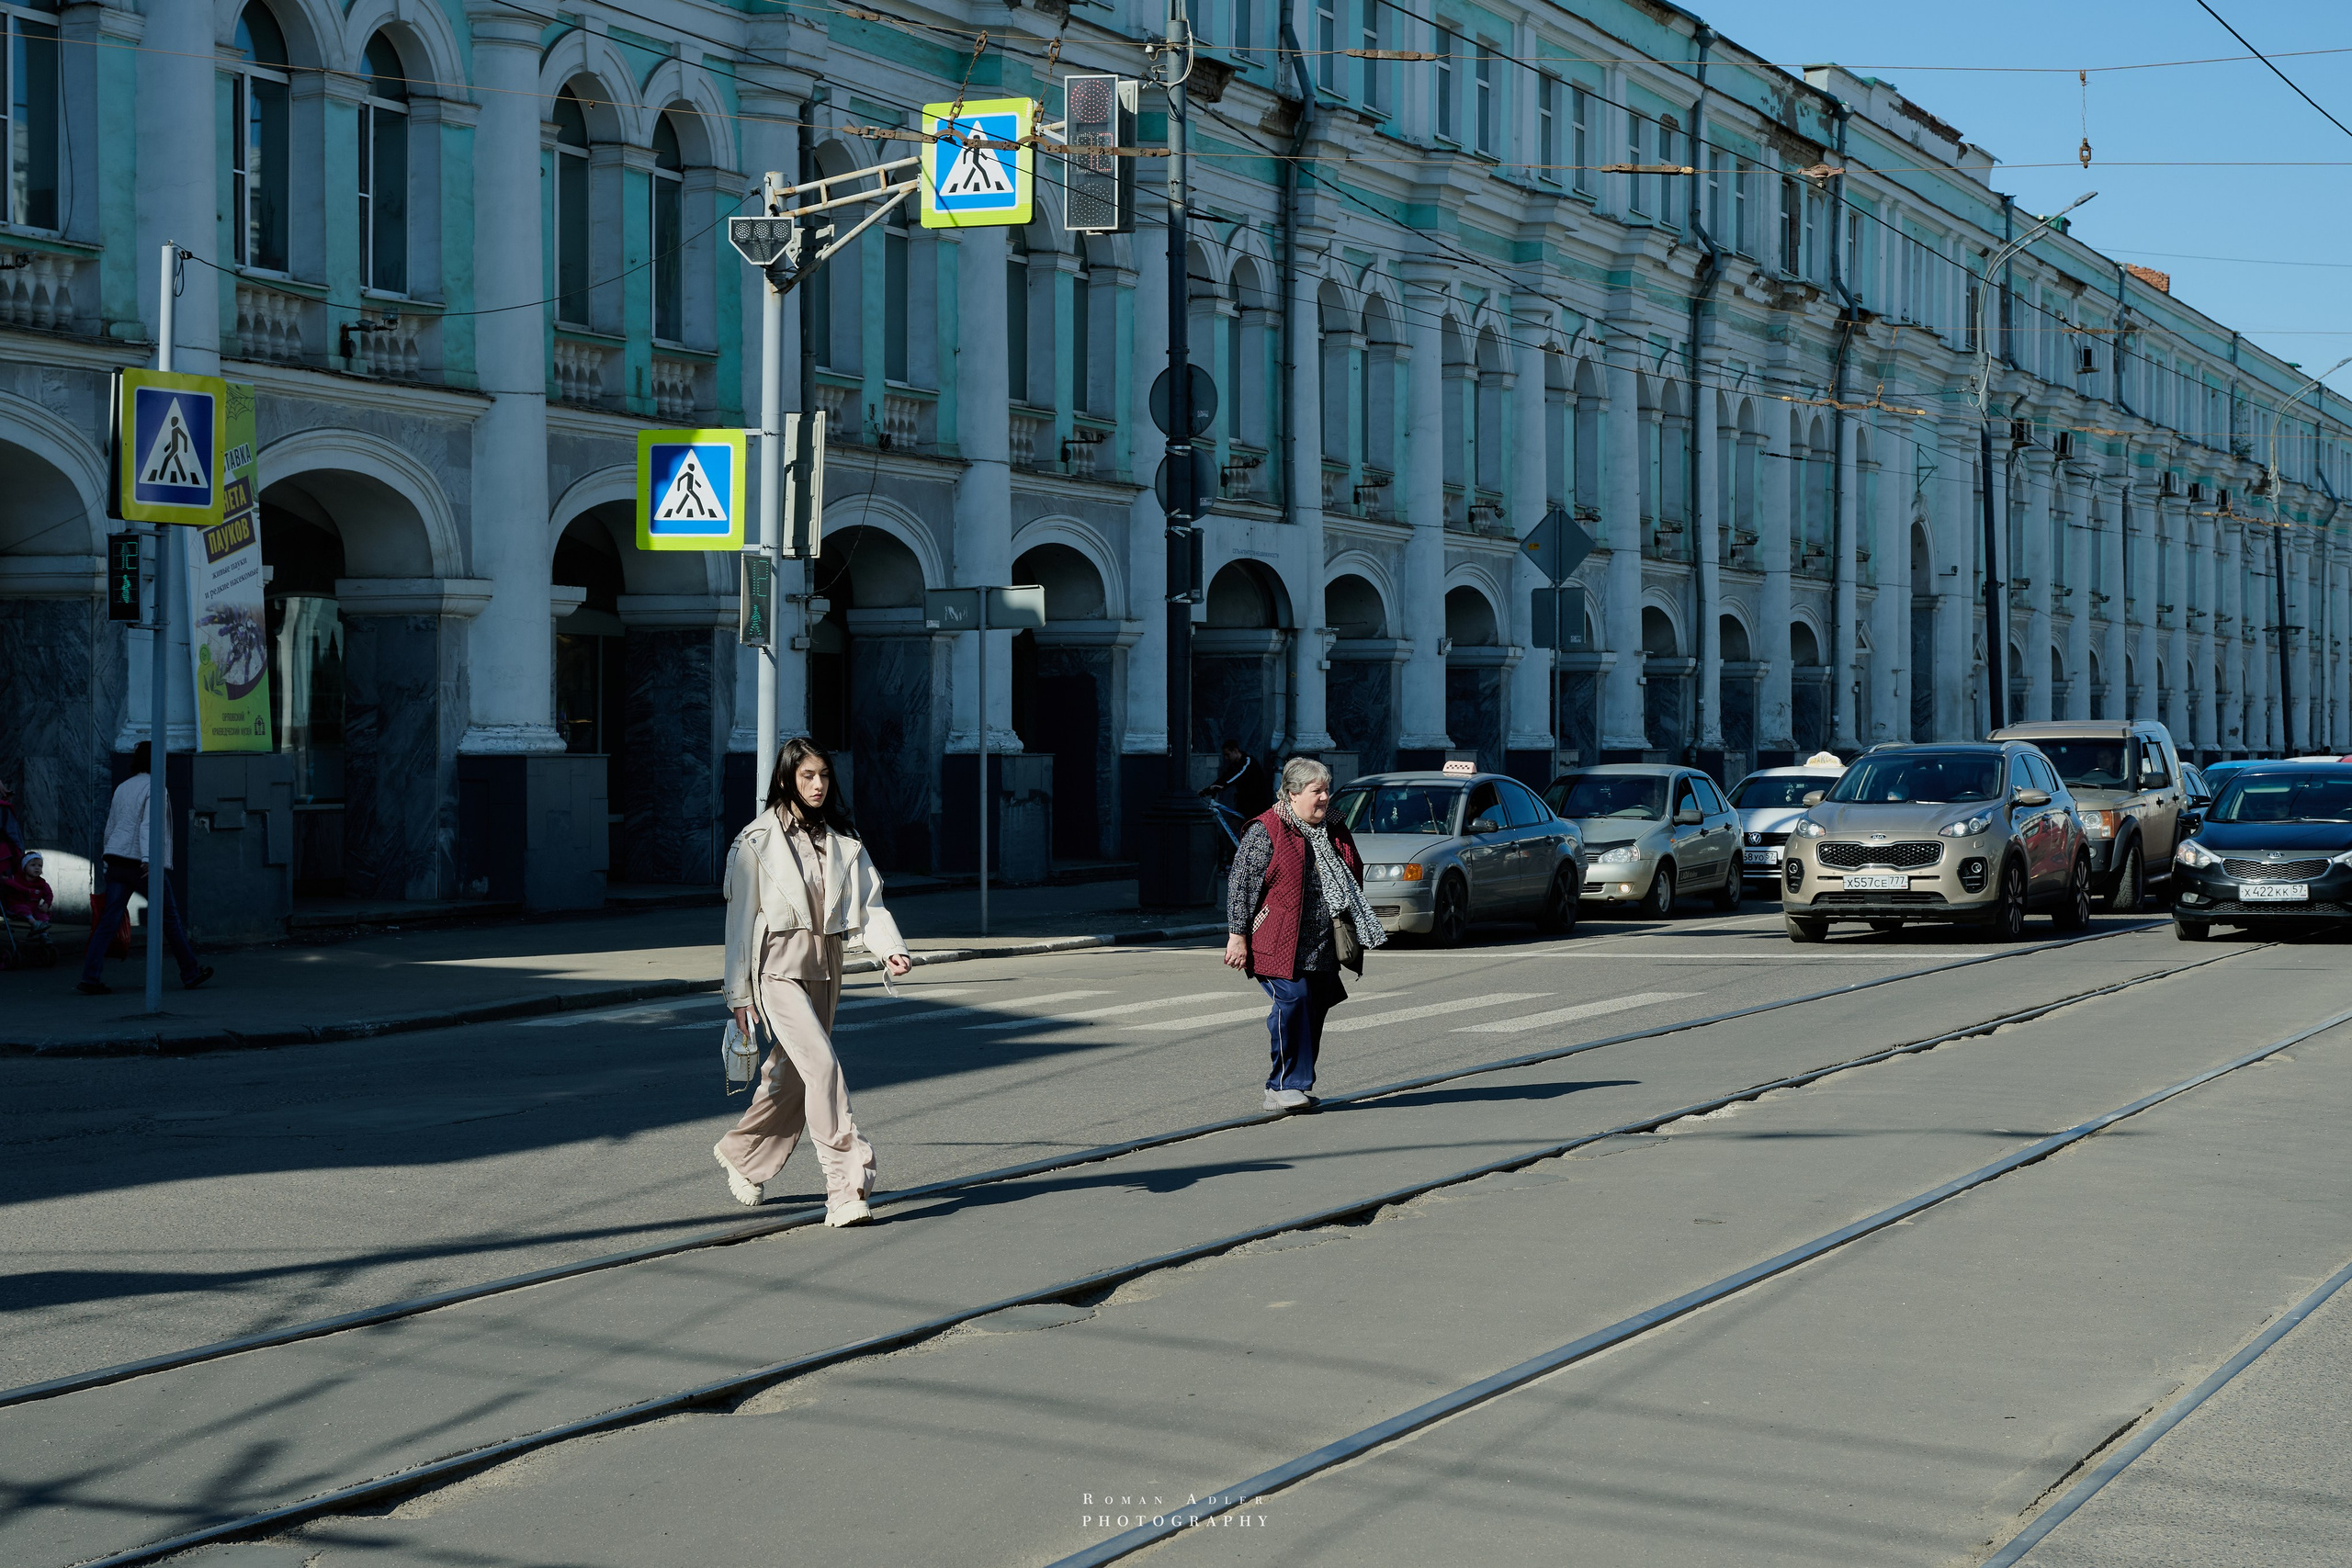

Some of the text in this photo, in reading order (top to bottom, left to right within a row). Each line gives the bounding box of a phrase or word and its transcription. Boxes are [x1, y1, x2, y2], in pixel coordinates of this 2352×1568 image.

[224, 444, 252, 472] ТАВКА
[208, 517, 250, 555] ПАУКОВ
[121, 542, 138, 570] 12
[211, 557, 247, 580] живые пауки
[209, 581, 230, 600] редкие
[230, 567, 259, 587] насекомые
[752, 559, 768, 597] 12
[1889, 876, 1905, 885] 777
[2292, 885, 2303, 893] 57
